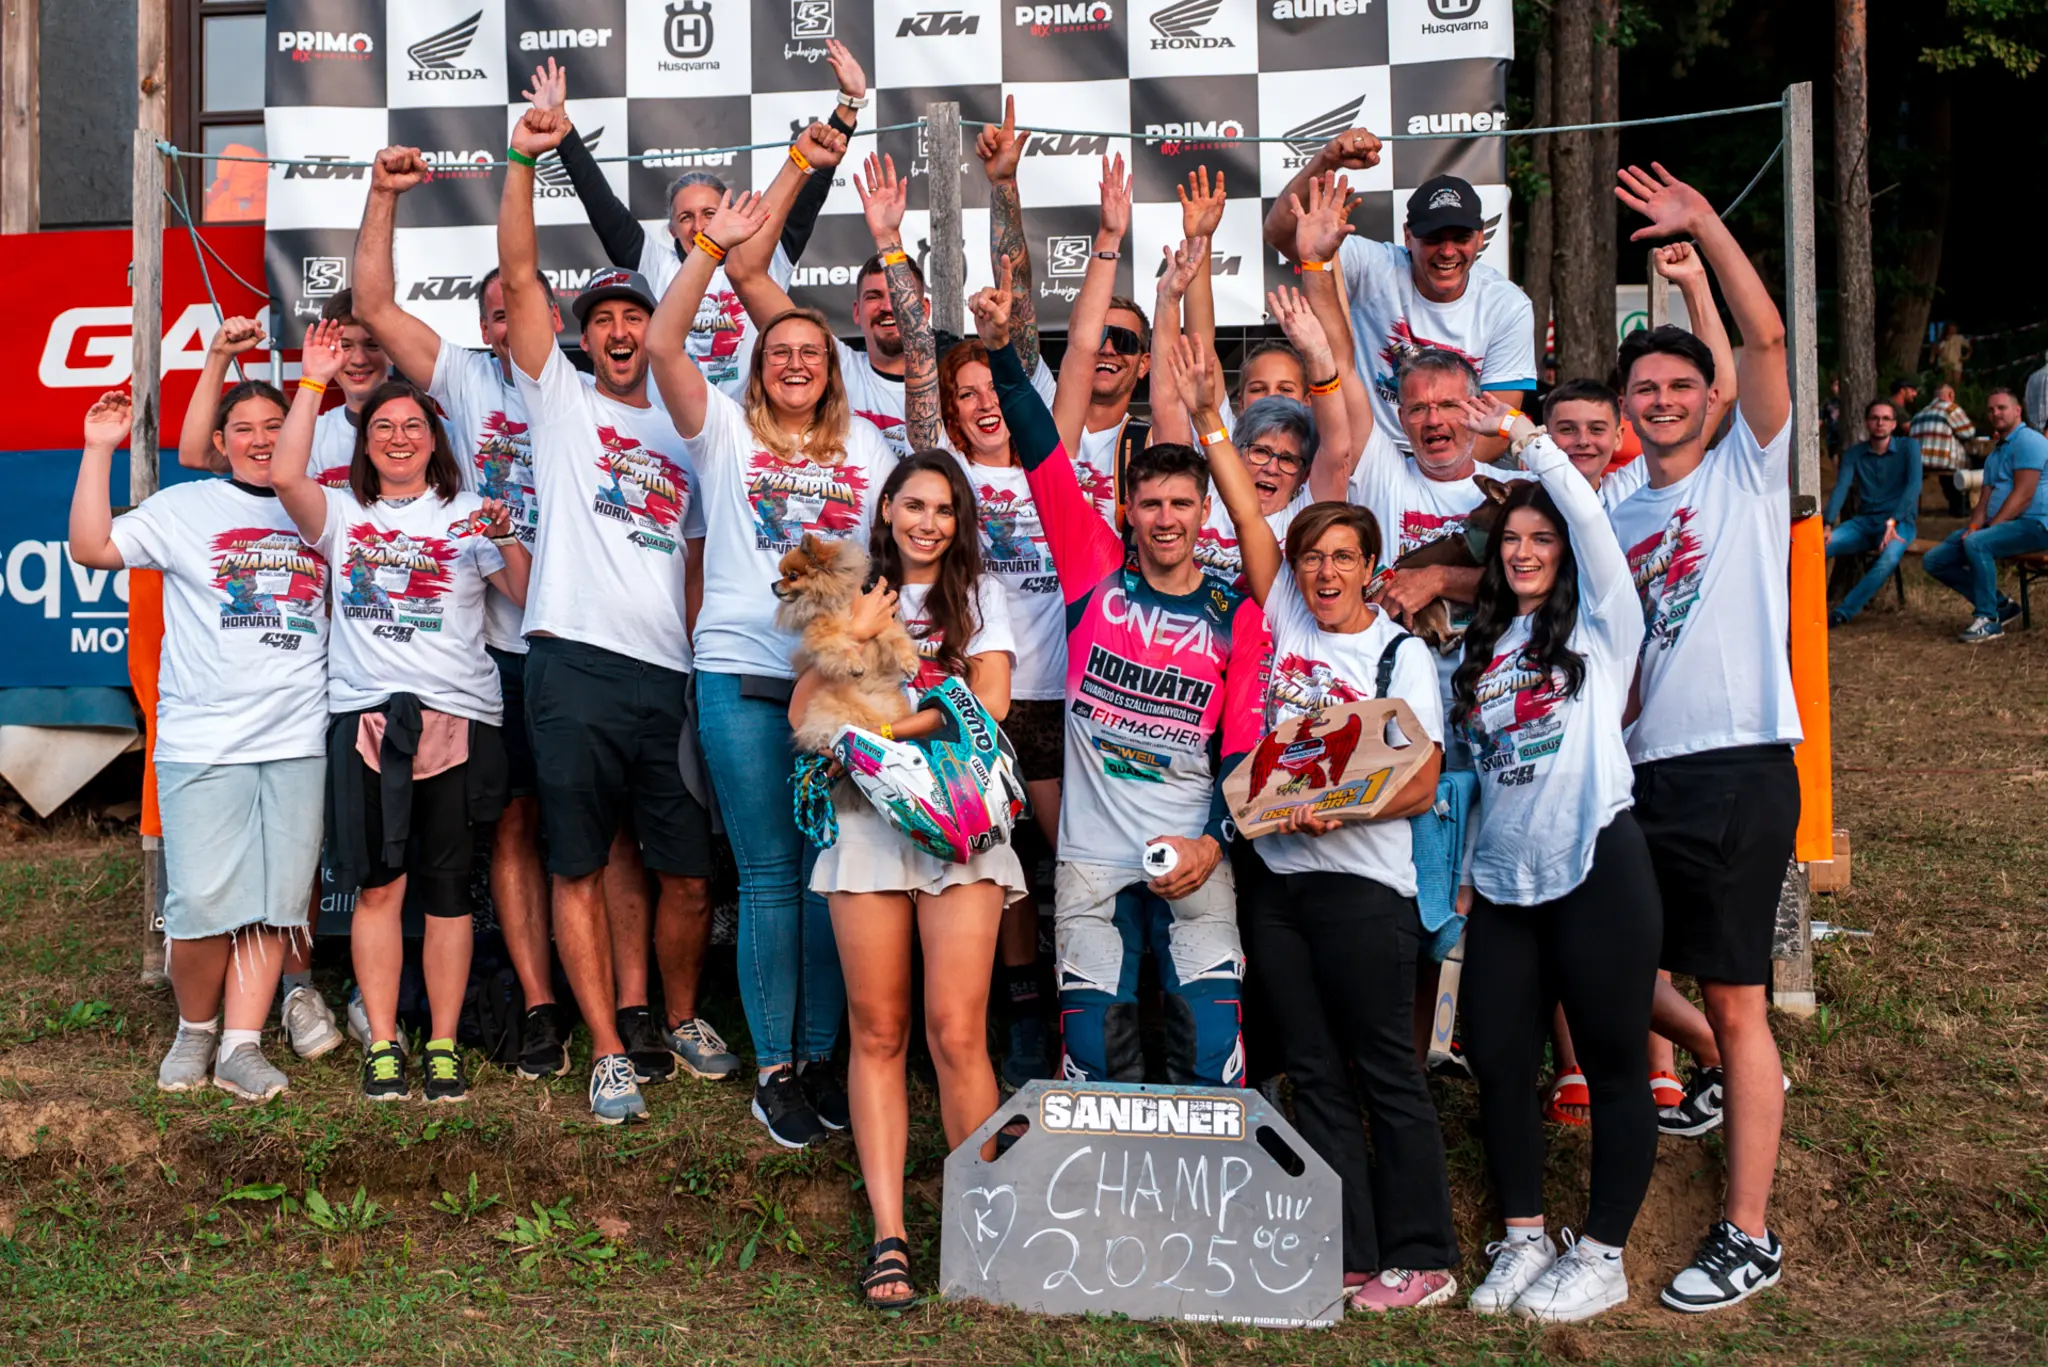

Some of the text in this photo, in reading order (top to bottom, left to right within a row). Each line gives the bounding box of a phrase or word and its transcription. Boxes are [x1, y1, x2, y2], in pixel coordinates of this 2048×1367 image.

[895, 10, 980, 37] KTM
[1015, 1, 1113, 26] PRIMO
[519, 27, 612, 52] auner
[1421, 20, 1489, 35] Husqvarna
[277, 31, 373, 52] PRIMO
[1149, 36, 1236, 49] HONDA
[407, 69, 488, 81] HONDA
[658, 60, 720, 72] Husqvarna
[1407, 111, 1508, 135] auner
[283, 155, 366, 180] KTM
[421, 150, 494, 171] RIMO
[642, 147, 738, 168] auner
[533, 186, 577, 199] HON
[790, 264, 863, 287] uner
[748, 471, 855, 508] CHAMPION
[216, 553, 318, 580] CHAMPION
[71, 627, 129, 653] MO
[1087, 646, 1213, 708] HORVÁTH
[1082, 680, 1114, 703] FUVAROZÓ
[1115, 695, 1123, 705] ÉS
[1187, 711, 1200, 724] KFT
[946, 686, 993, 753] QUABUS
[1076, 706, 1089, 717] die
[1091, 707, 1201, 747] FITMACHER
[857, 739, 882, 759] QUABUS
[971, 758, 991, 787] SHOEI
[1359, 766, 1394, 805] 1
[1044, 1095, 1241, 1137] SANDNER
[1046, 1146, 1253, 1232] CHAMP
[974, 1208, 999, 1242] K
[1023, 1227, 1238, 1296] 2025
[1253, 1316, 1288, 1325] RIDERS
